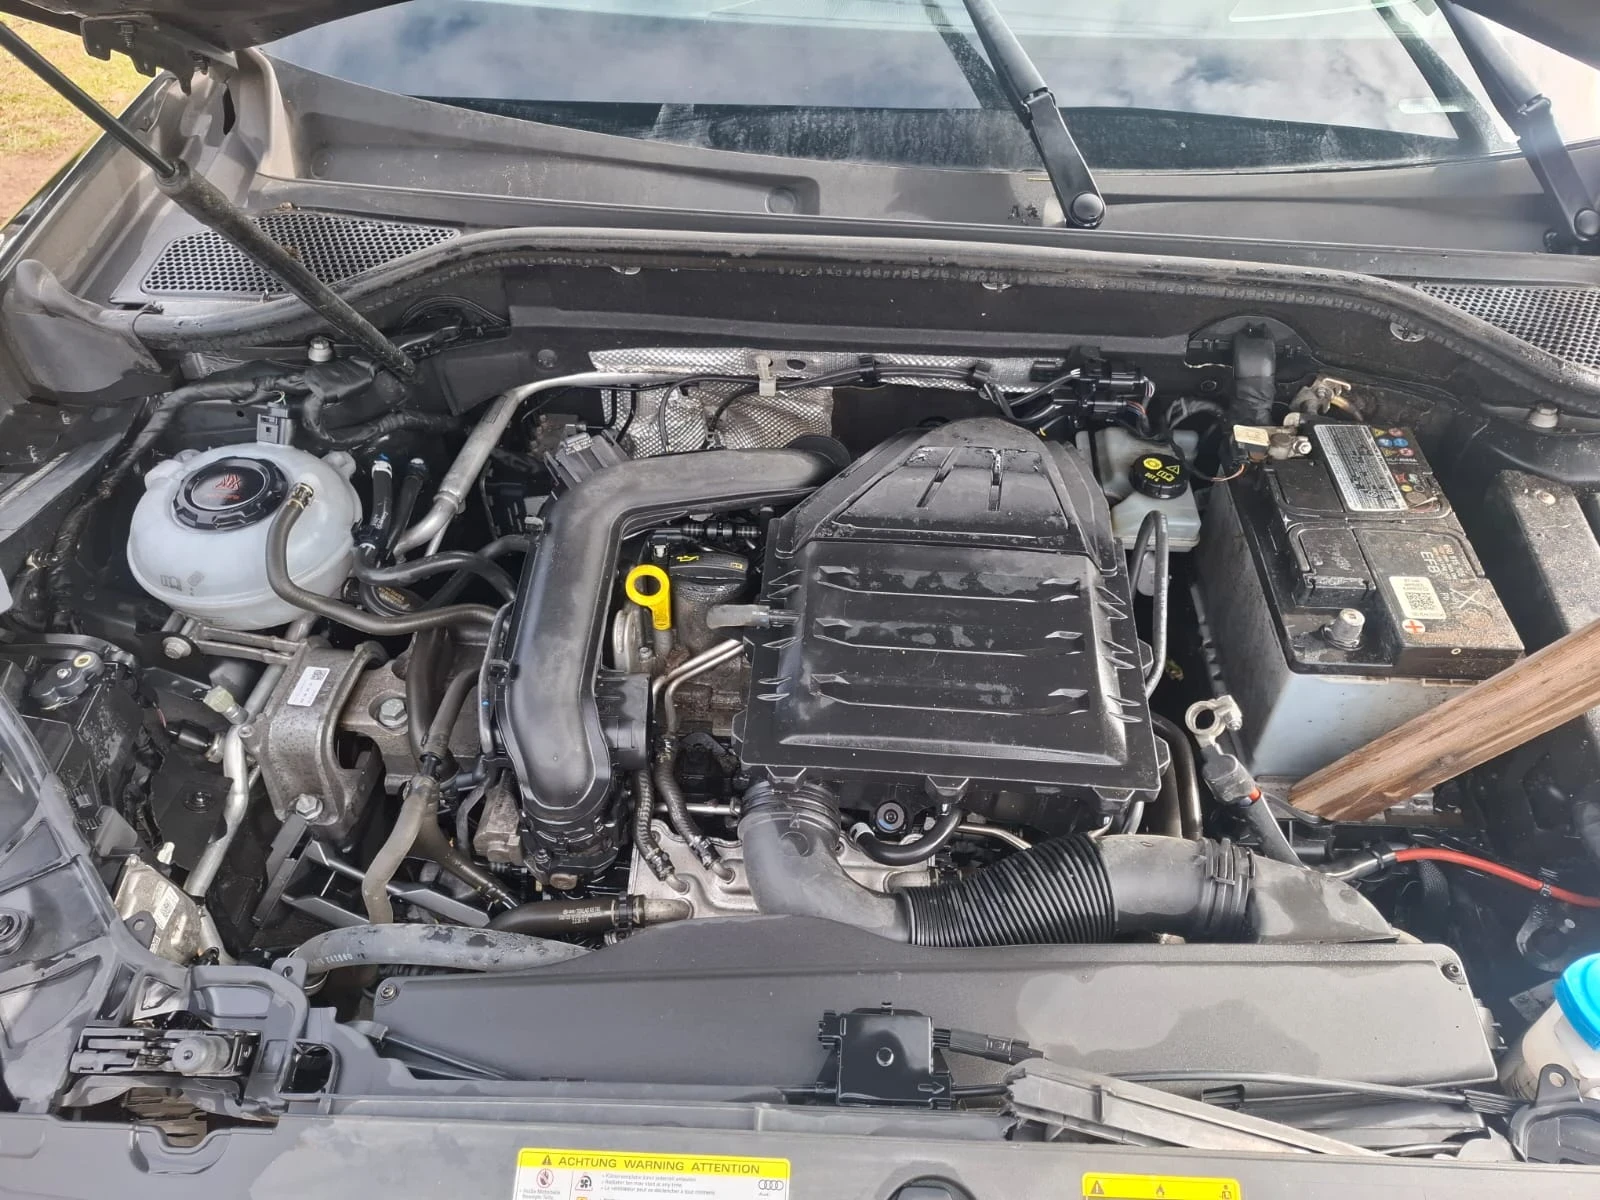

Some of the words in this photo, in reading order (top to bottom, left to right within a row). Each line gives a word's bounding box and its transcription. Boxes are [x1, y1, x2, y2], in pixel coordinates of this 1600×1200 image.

[1420, 551, 1441, 573] EFB
[558, 1156, 617, 1168] ACHTUNG
[624, 1159, 684, 1171] WARNING
[691, 1162, 760, 1174] ATTENTION
